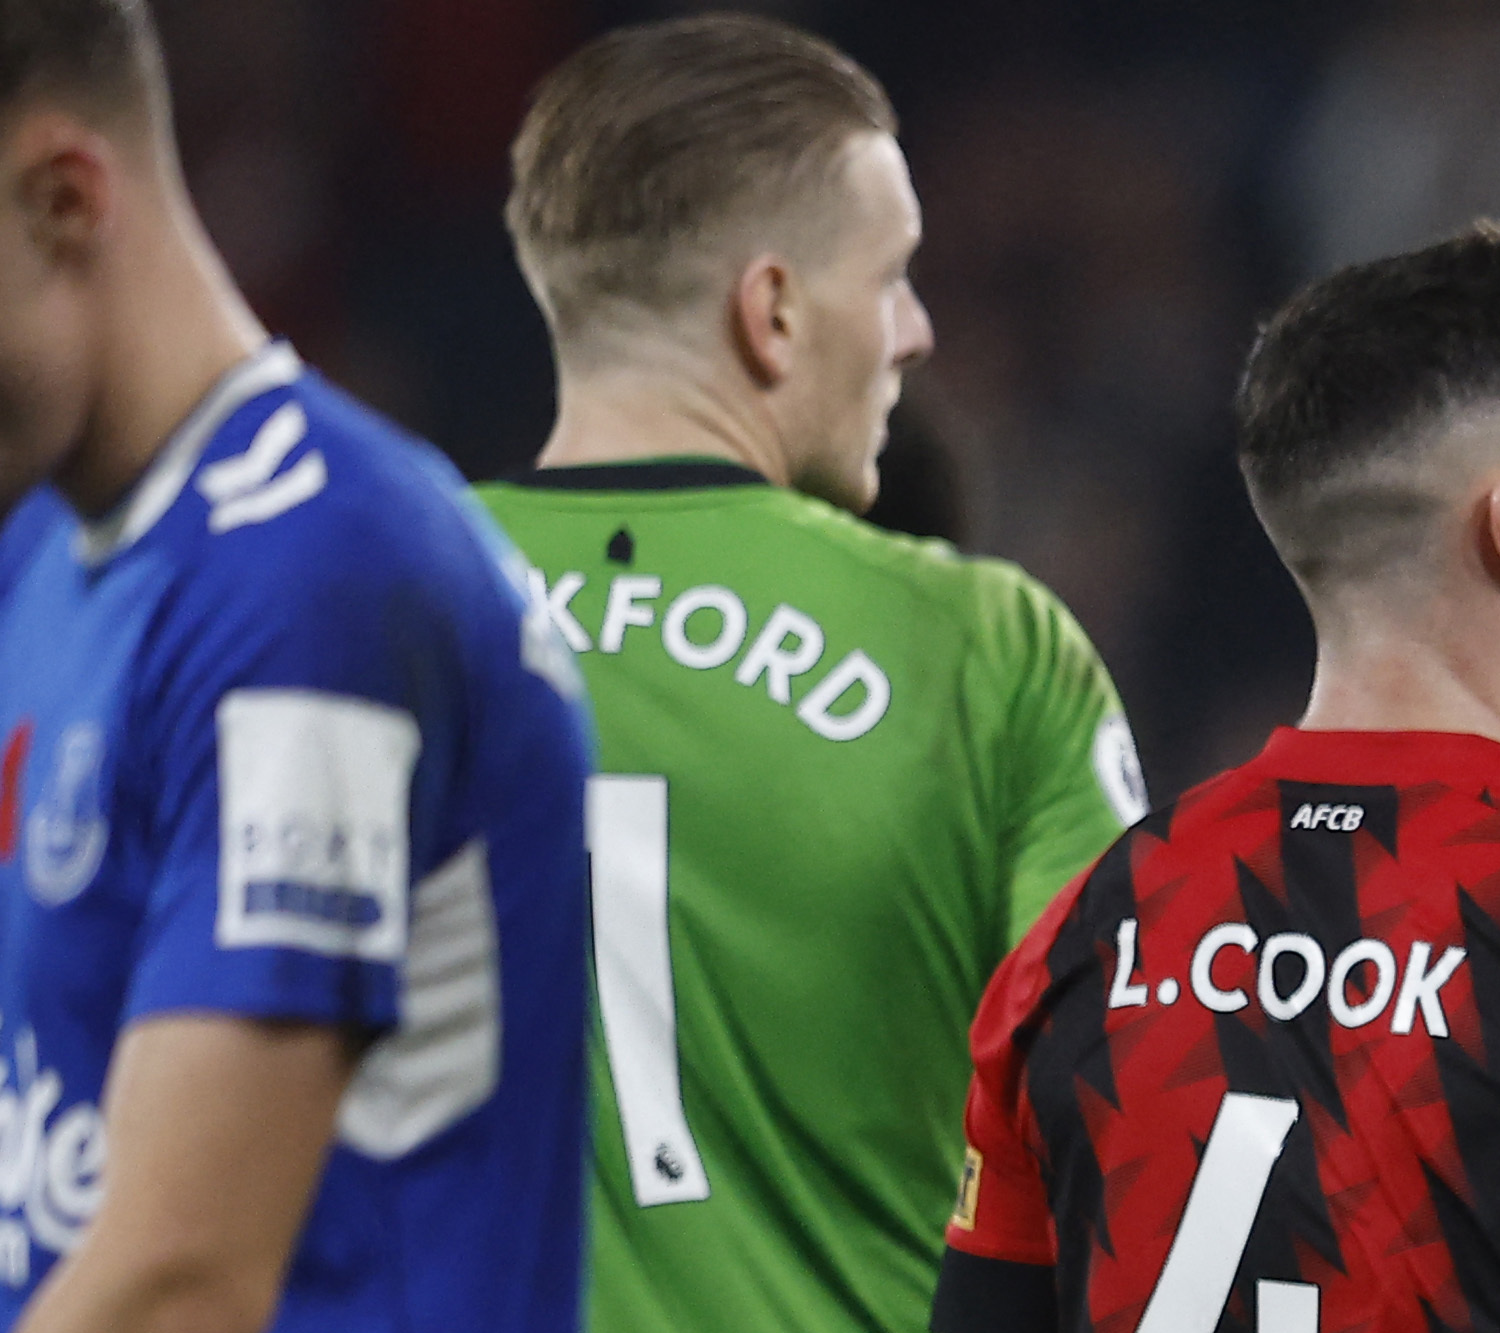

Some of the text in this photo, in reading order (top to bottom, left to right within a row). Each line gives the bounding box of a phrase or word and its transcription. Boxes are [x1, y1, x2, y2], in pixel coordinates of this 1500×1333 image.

[526, 568, 892, 743] KFORD
[1289, 801, 1366, 832] AFCB
[585, 773, 711, 1207] 1
[1107, 917, 1468, 1038] L.COOK
